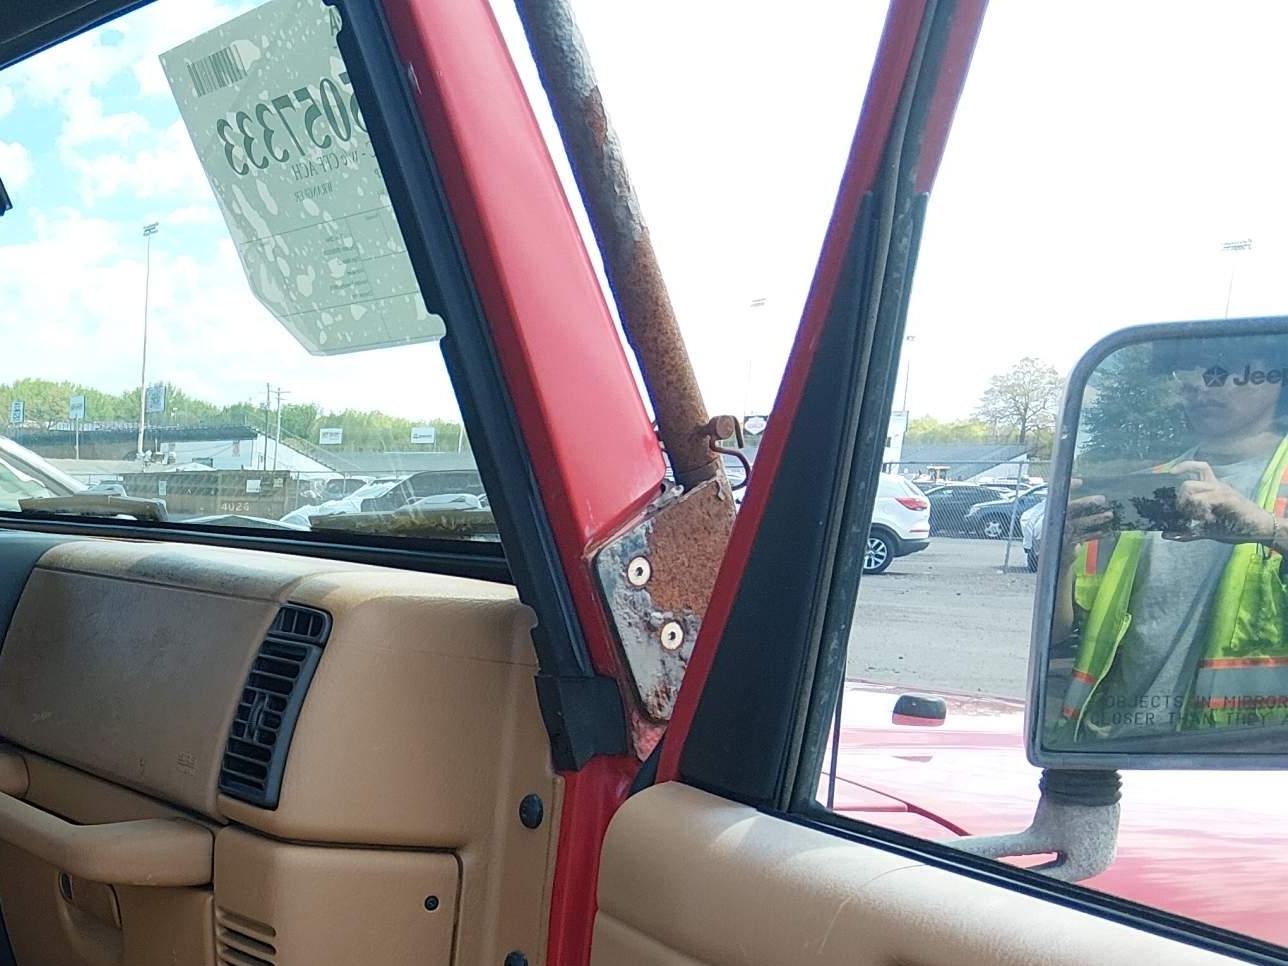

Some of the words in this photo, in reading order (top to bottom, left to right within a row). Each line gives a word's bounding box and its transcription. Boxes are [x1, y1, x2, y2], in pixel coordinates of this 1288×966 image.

[1106, 695, 1183, 709] OBJECTS
[1192, 695, 1211, 709] IN
[1223, 695, 1288, 710] MIRROR
[1090, 711, 1155, 726] CLOSER
[1168, 711, 1216, 726] THAN
[1226, 711, 1269, 728] THEY
